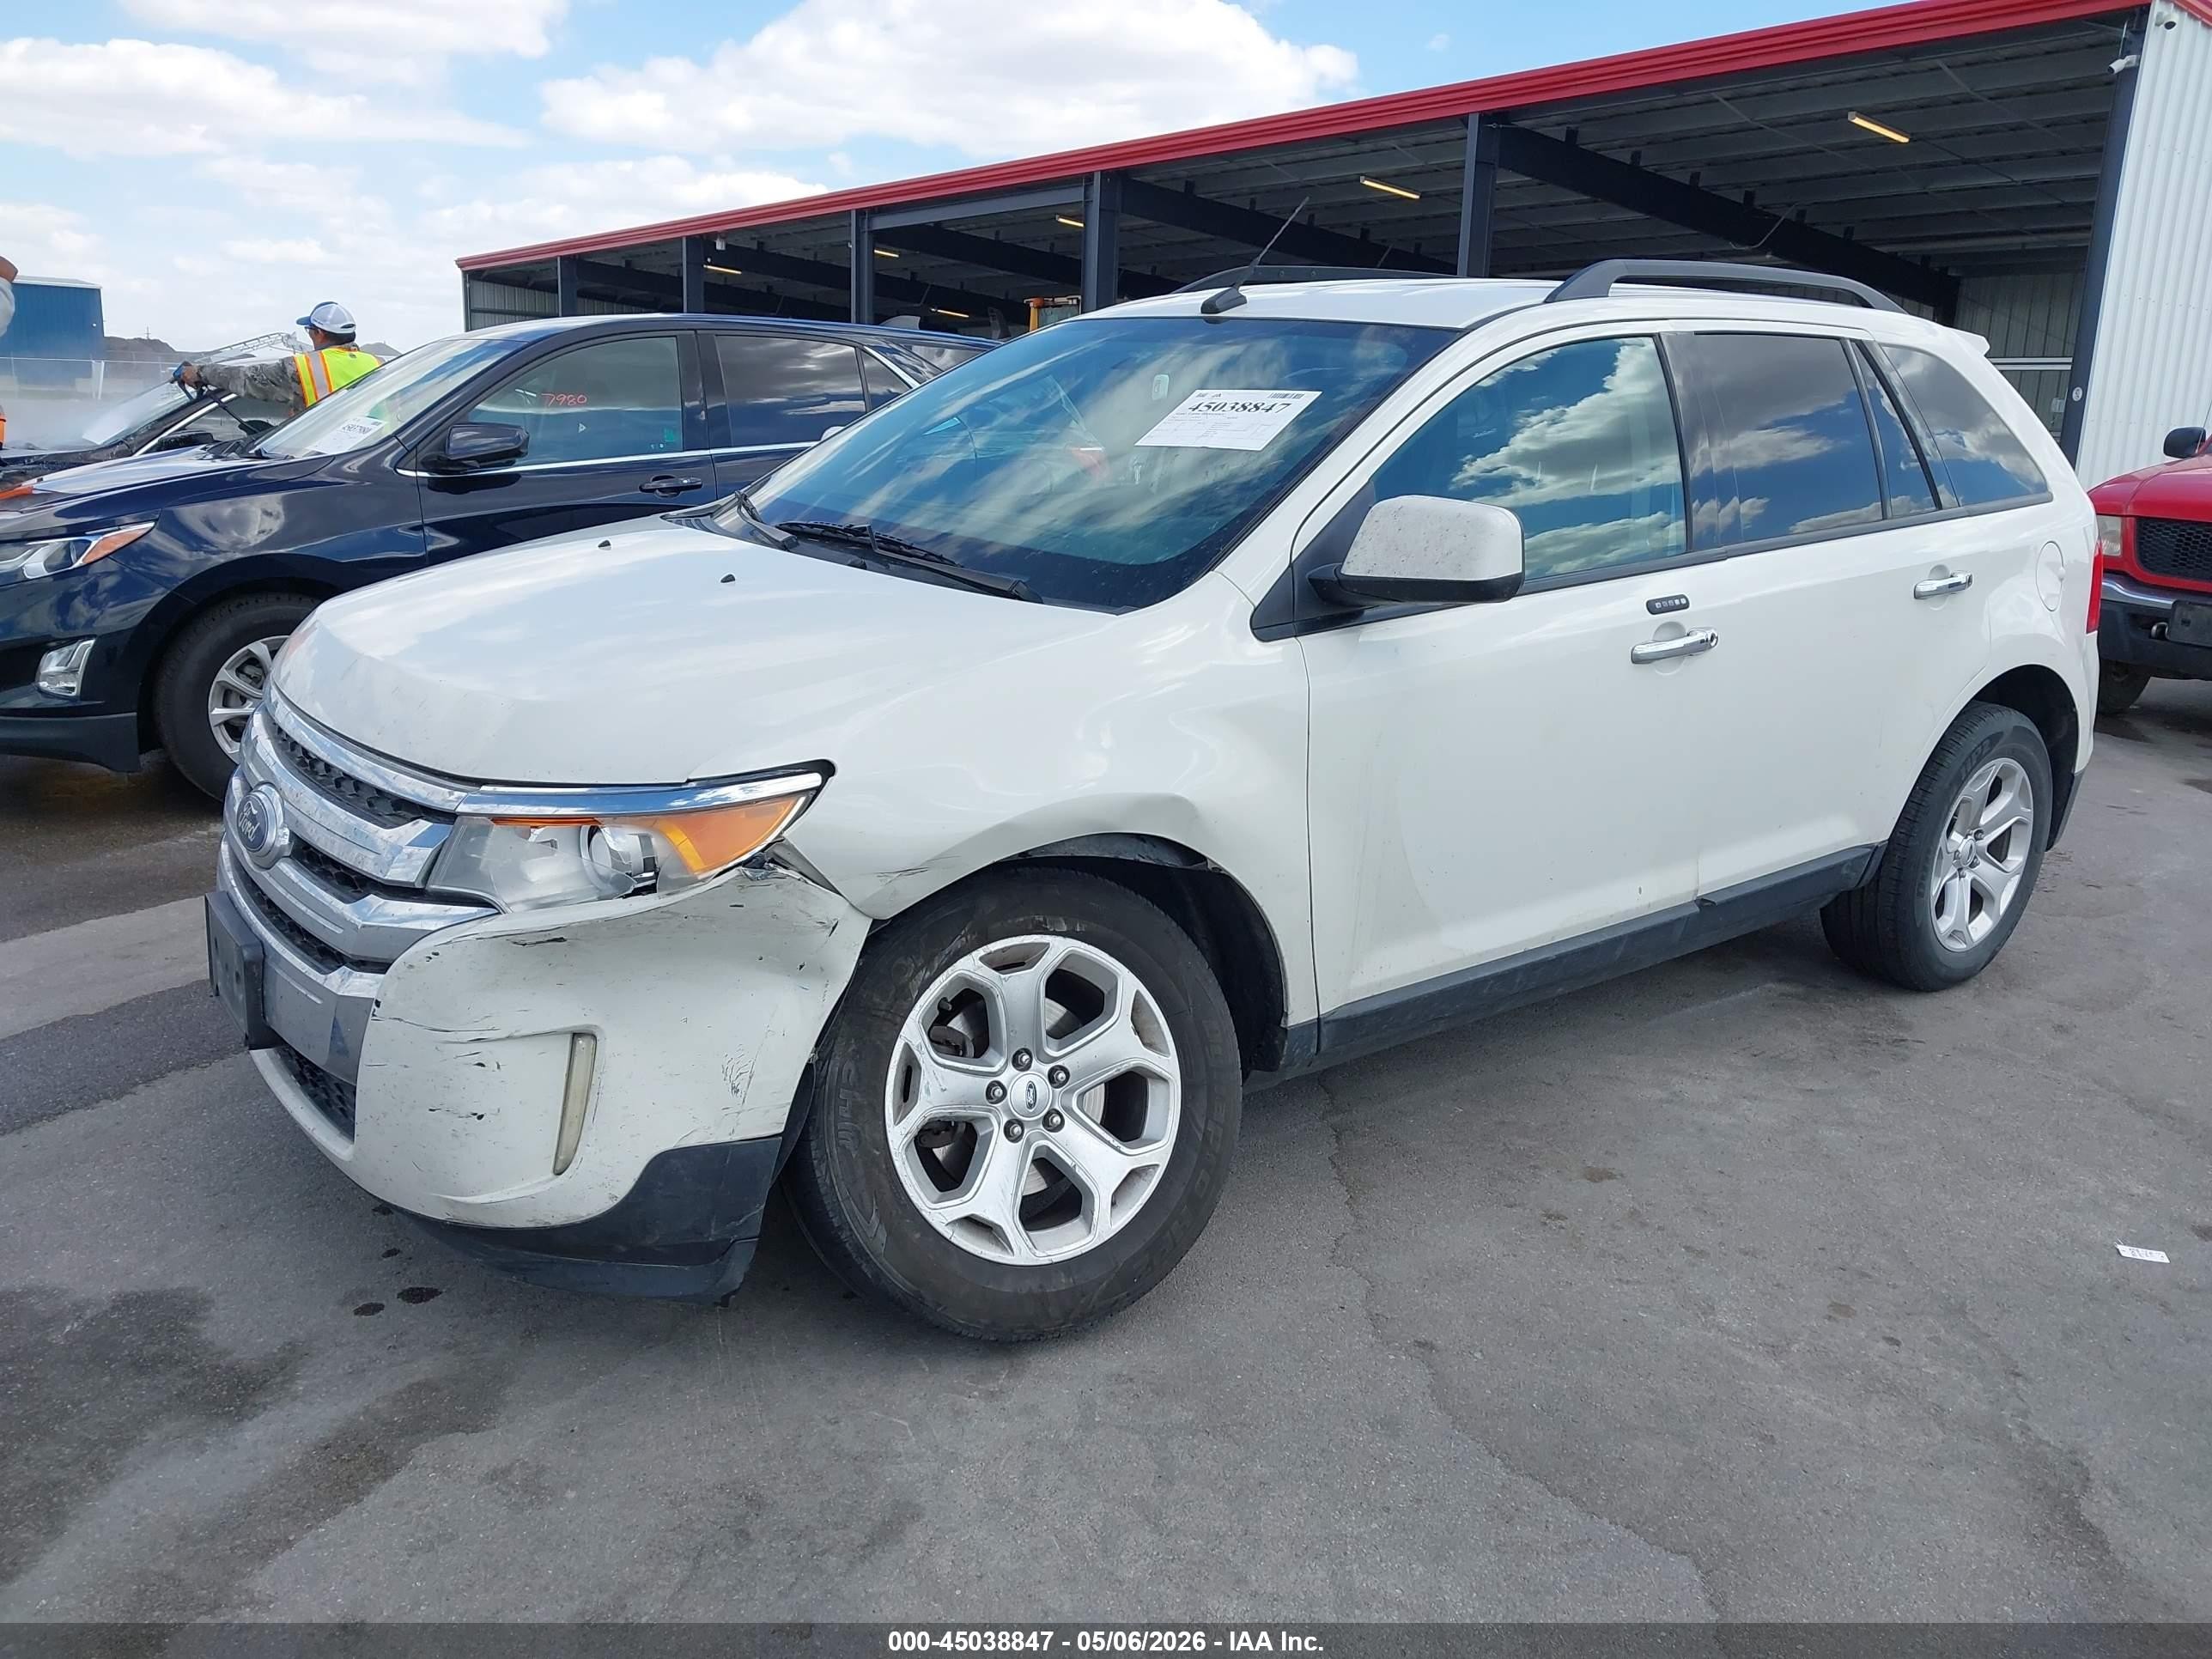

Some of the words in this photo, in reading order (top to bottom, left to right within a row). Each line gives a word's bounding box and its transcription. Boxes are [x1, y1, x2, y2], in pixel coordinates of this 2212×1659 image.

[541, 393, 587, 407] 7980
[1188, 402, 1292, 413] 45038847
[238, 800, 260, 842] Ford
